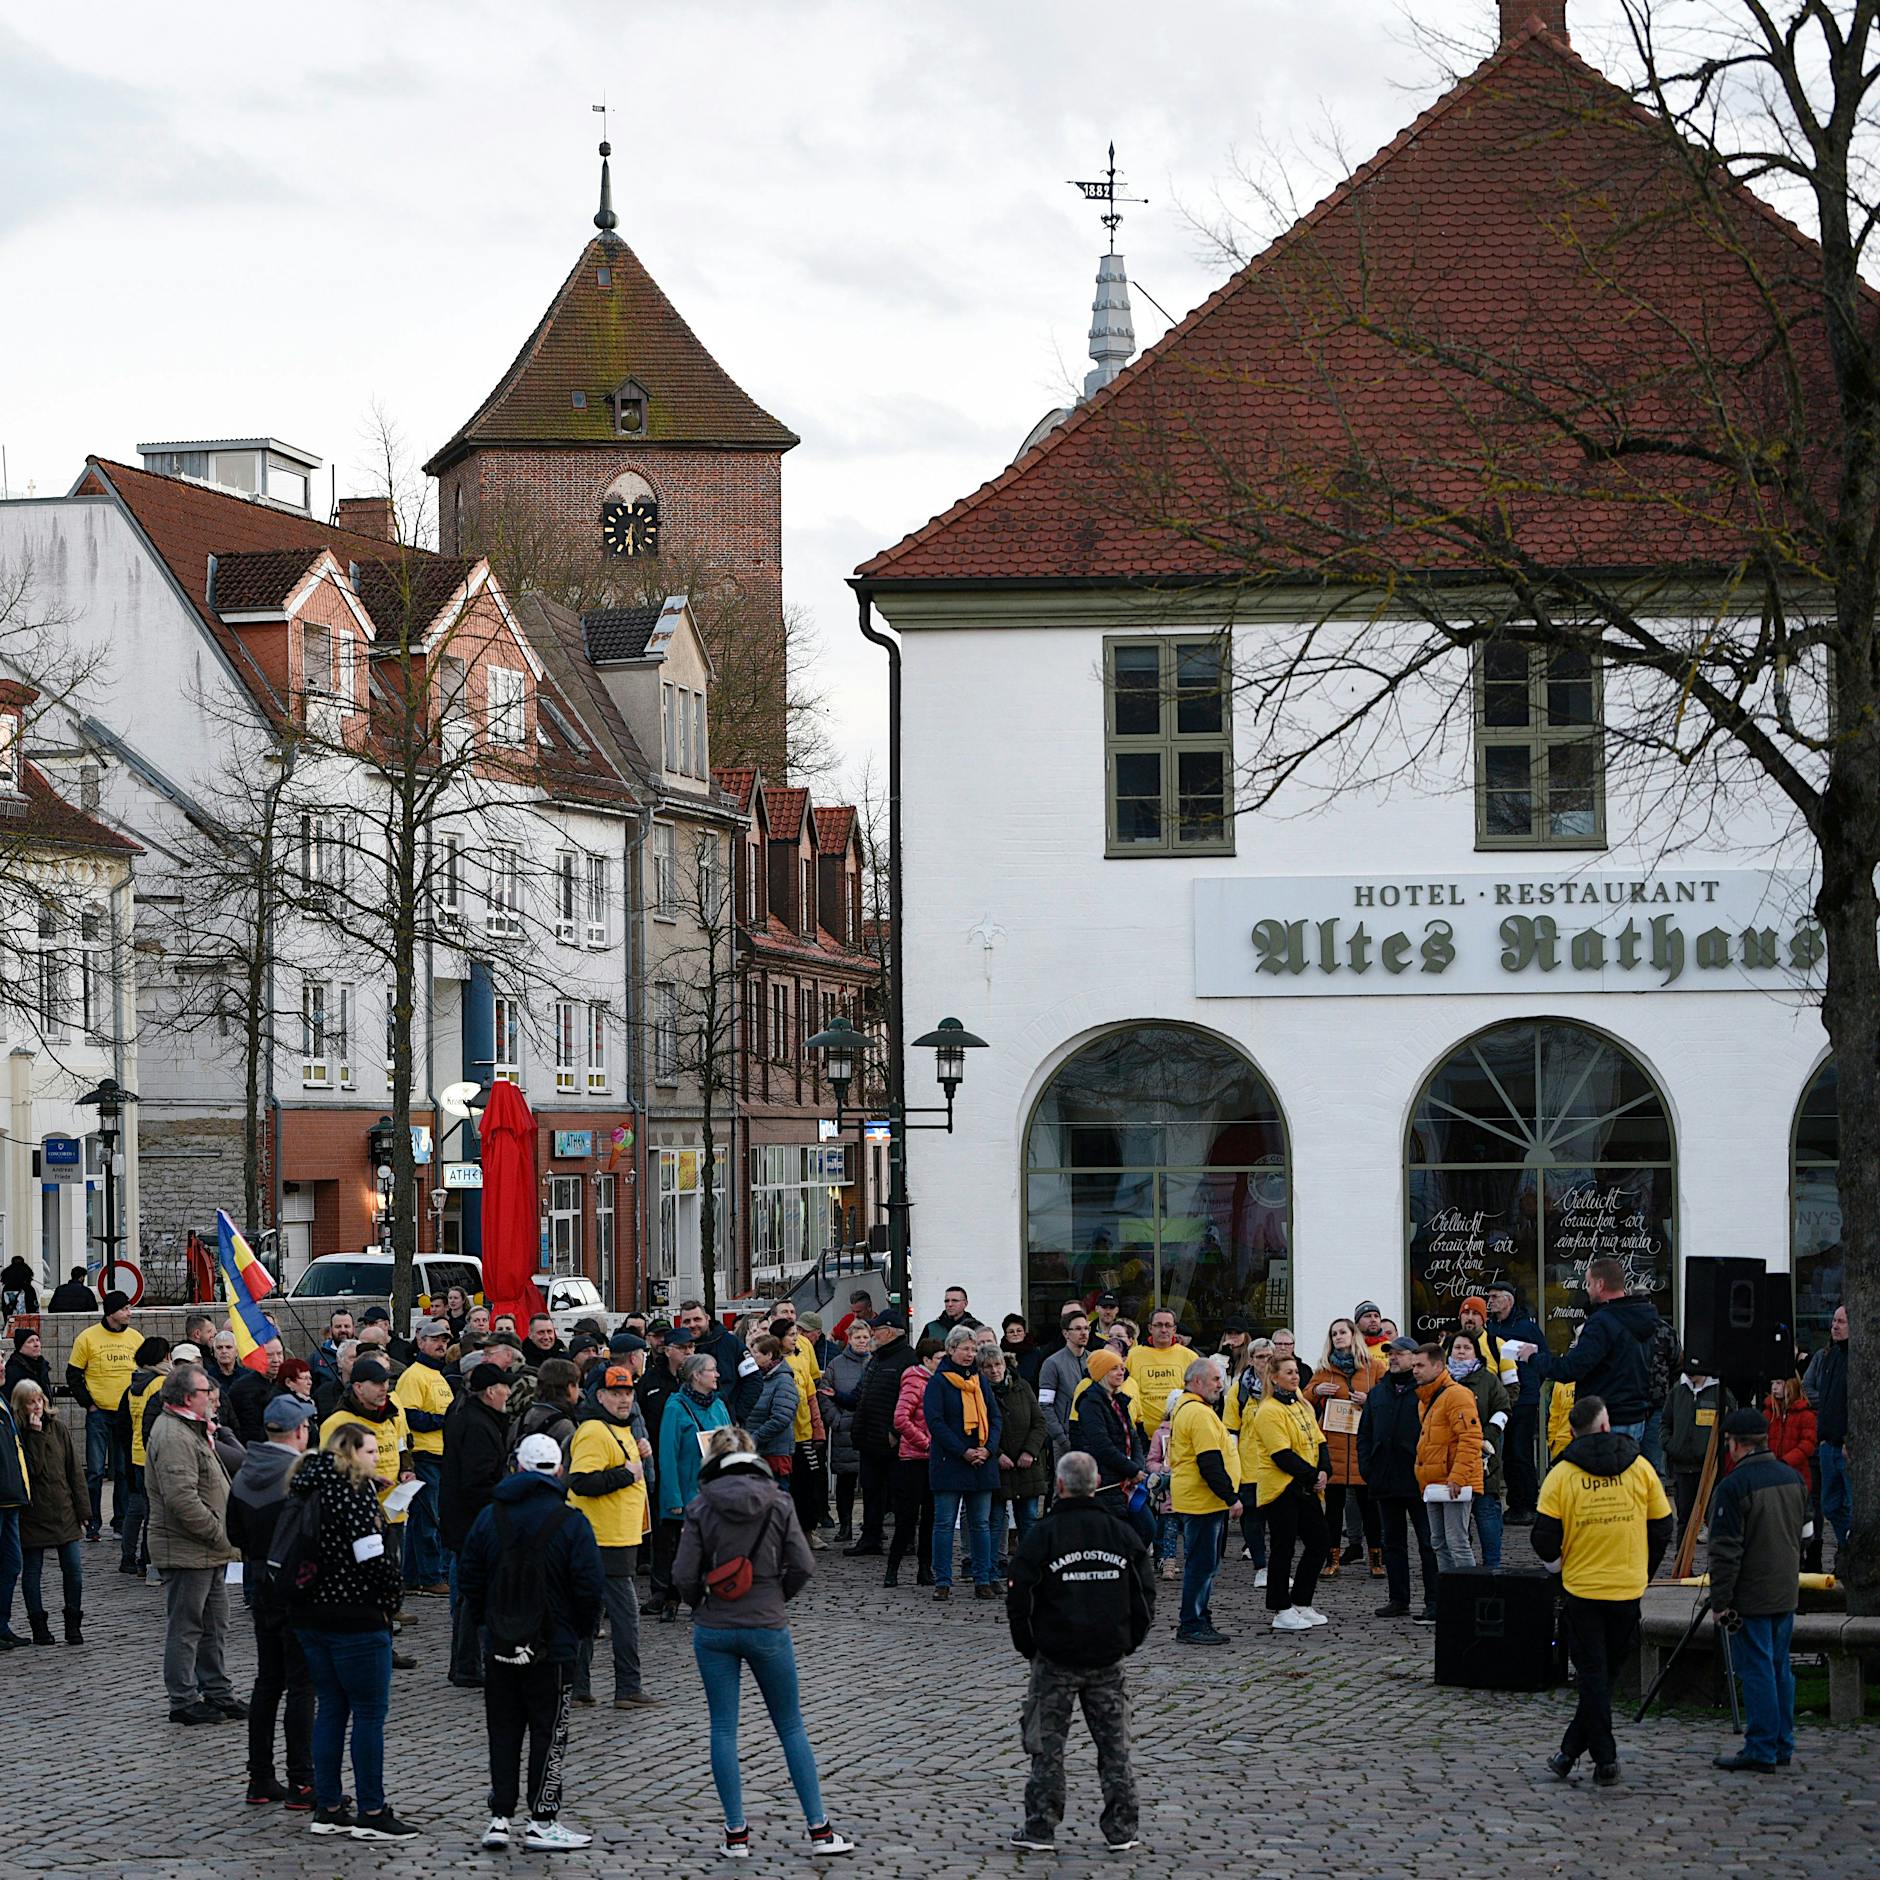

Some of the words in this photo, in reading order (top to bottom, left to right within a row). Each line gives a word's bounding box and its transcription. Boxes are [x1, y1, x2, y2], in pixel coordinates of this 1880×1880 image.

[1083, 184, 1110, 198] 1882
[1353, 884, 1465, 907] HOTEL
[1494, 880, 1721, 905] RESTAURANT
[1251, 917, 1456, 976] Altes
[1499, 912, 1826, 987] Rathaus
[1490, 1236, 1518, 1254] wir
[1147, 1369, 1175, 1379] Upahl
[378, 1442, 396, 1456] pahl
[1581, 1474, 1624, 1492] Upahl
[1048, 1551, 1082, 1573] MARIO
[1061, 1569, 1120, 1582] BAUBETRIEB
